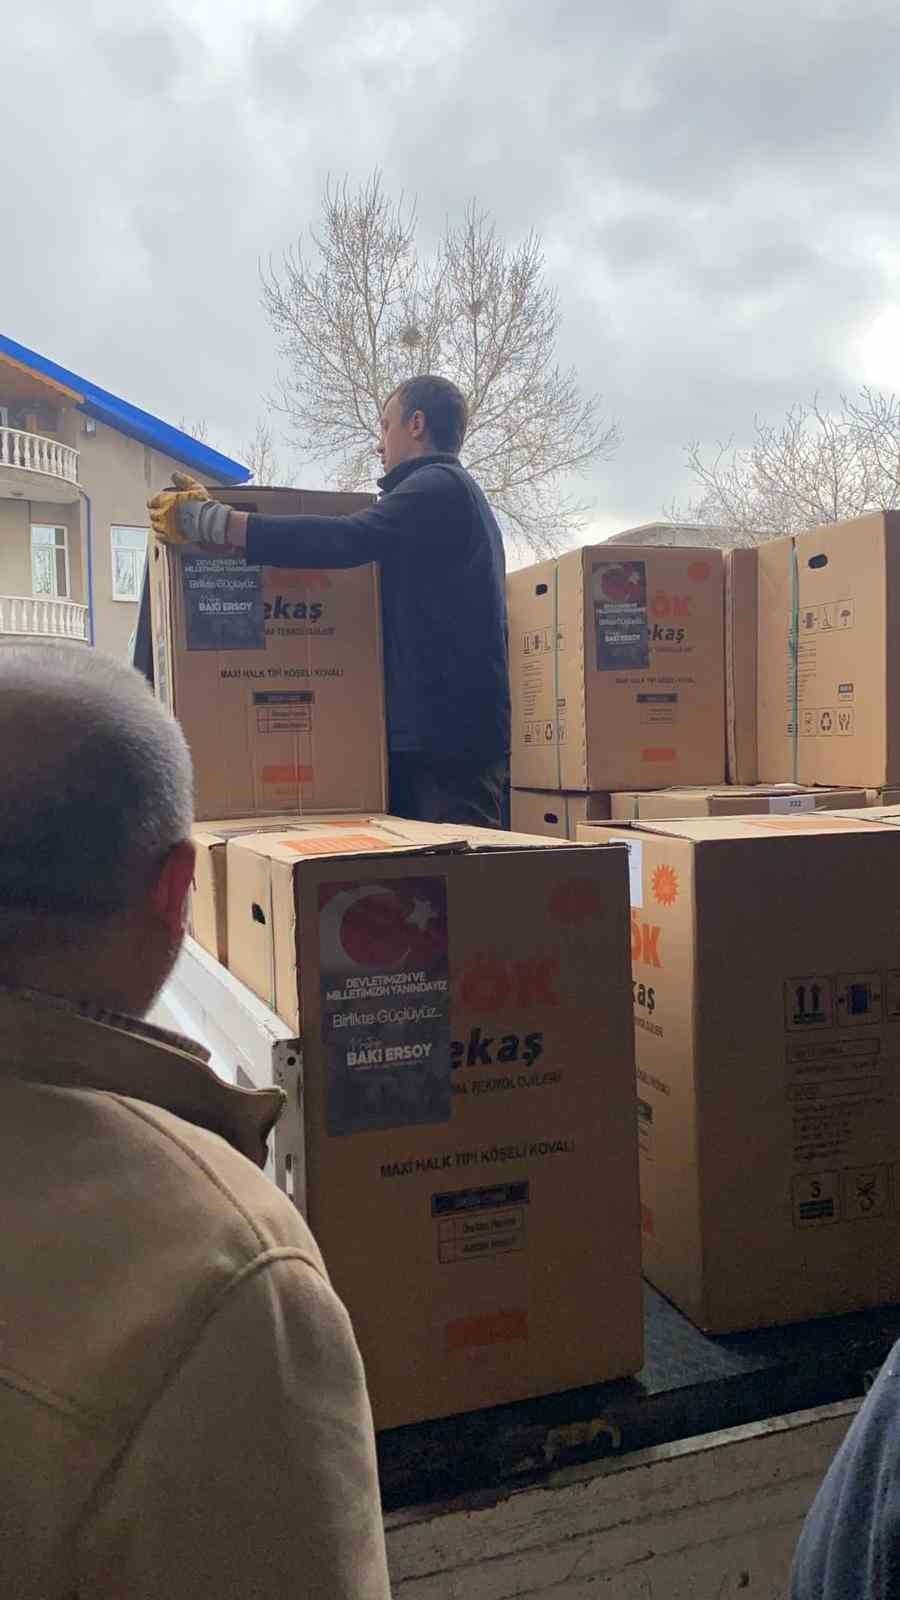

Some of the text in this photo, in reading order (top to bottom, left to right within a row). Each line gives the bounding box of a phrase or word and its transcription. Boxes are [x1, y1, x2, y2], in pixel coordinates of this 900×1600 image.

[333, 1012, 375, 1028] Birlikte
[385, 1043, 432, 1062] ERSOY
[415, 1152, 452, 1171] HALK
